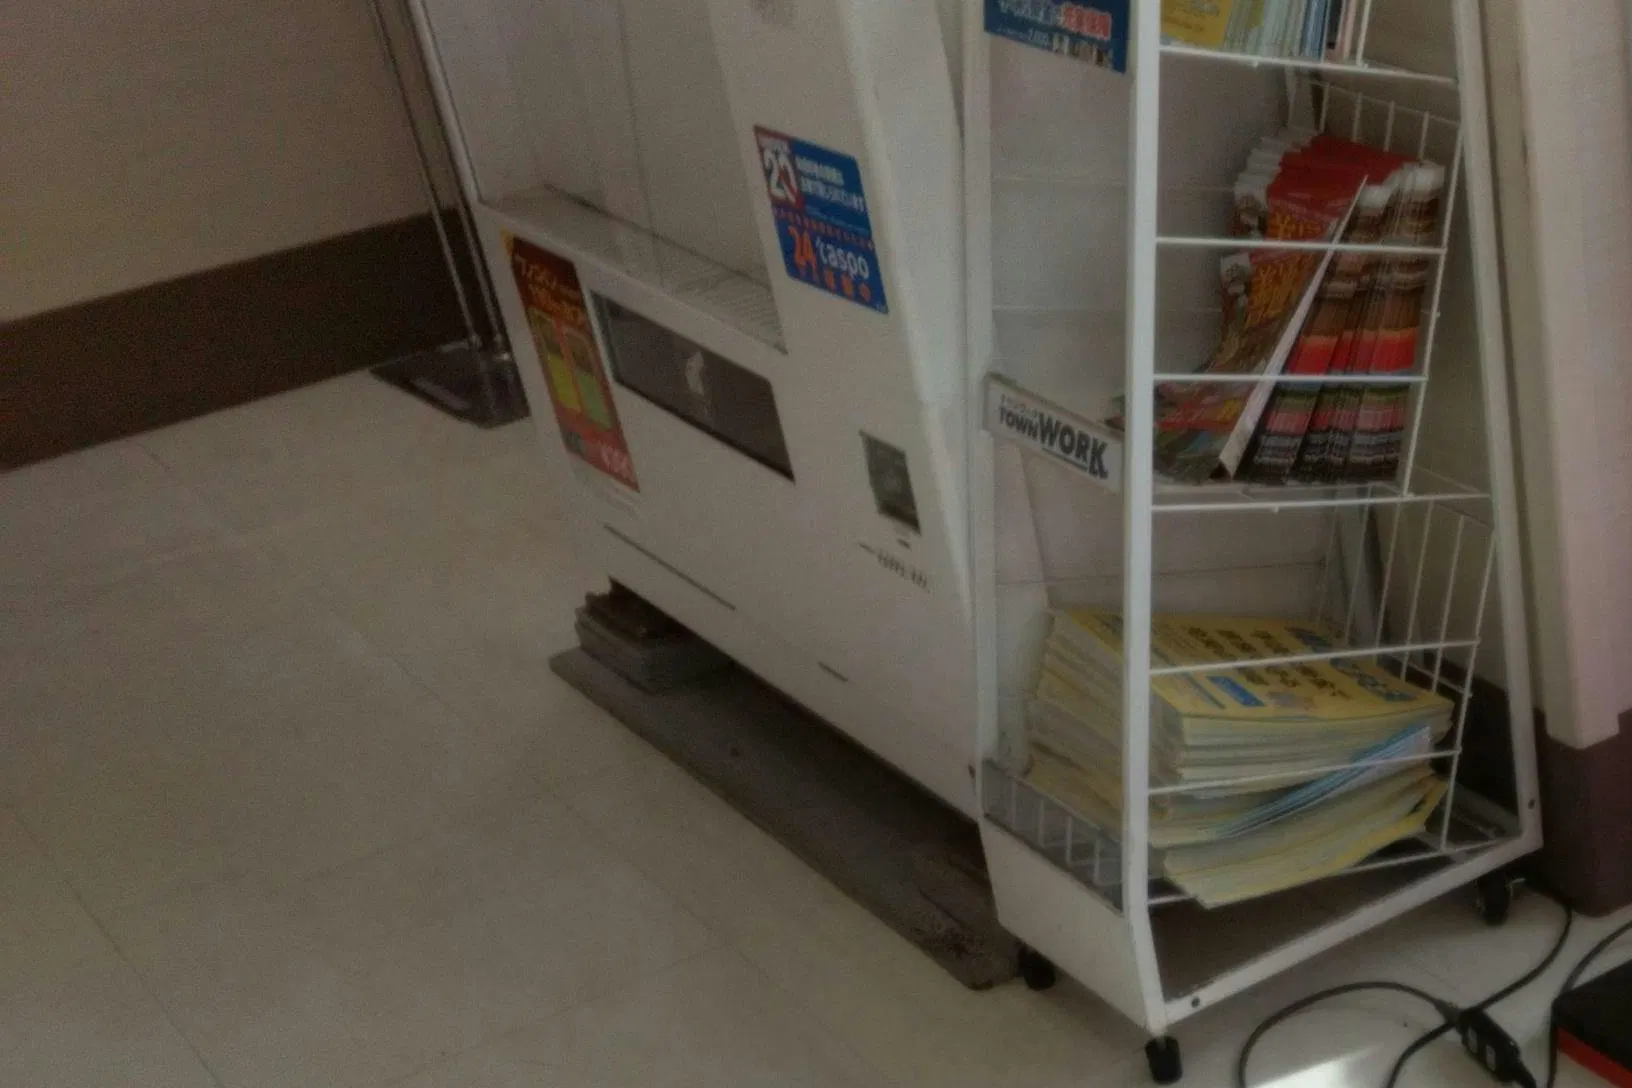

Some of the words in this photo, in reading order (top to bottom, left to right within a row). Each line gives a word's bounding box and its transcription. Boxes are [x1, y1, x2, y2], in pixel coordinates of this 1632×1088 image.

[816, 236, 869, 280] taspo
[999, 406, 1039, 441] TOWN
[1038, 411, 1109, 479] WORK
